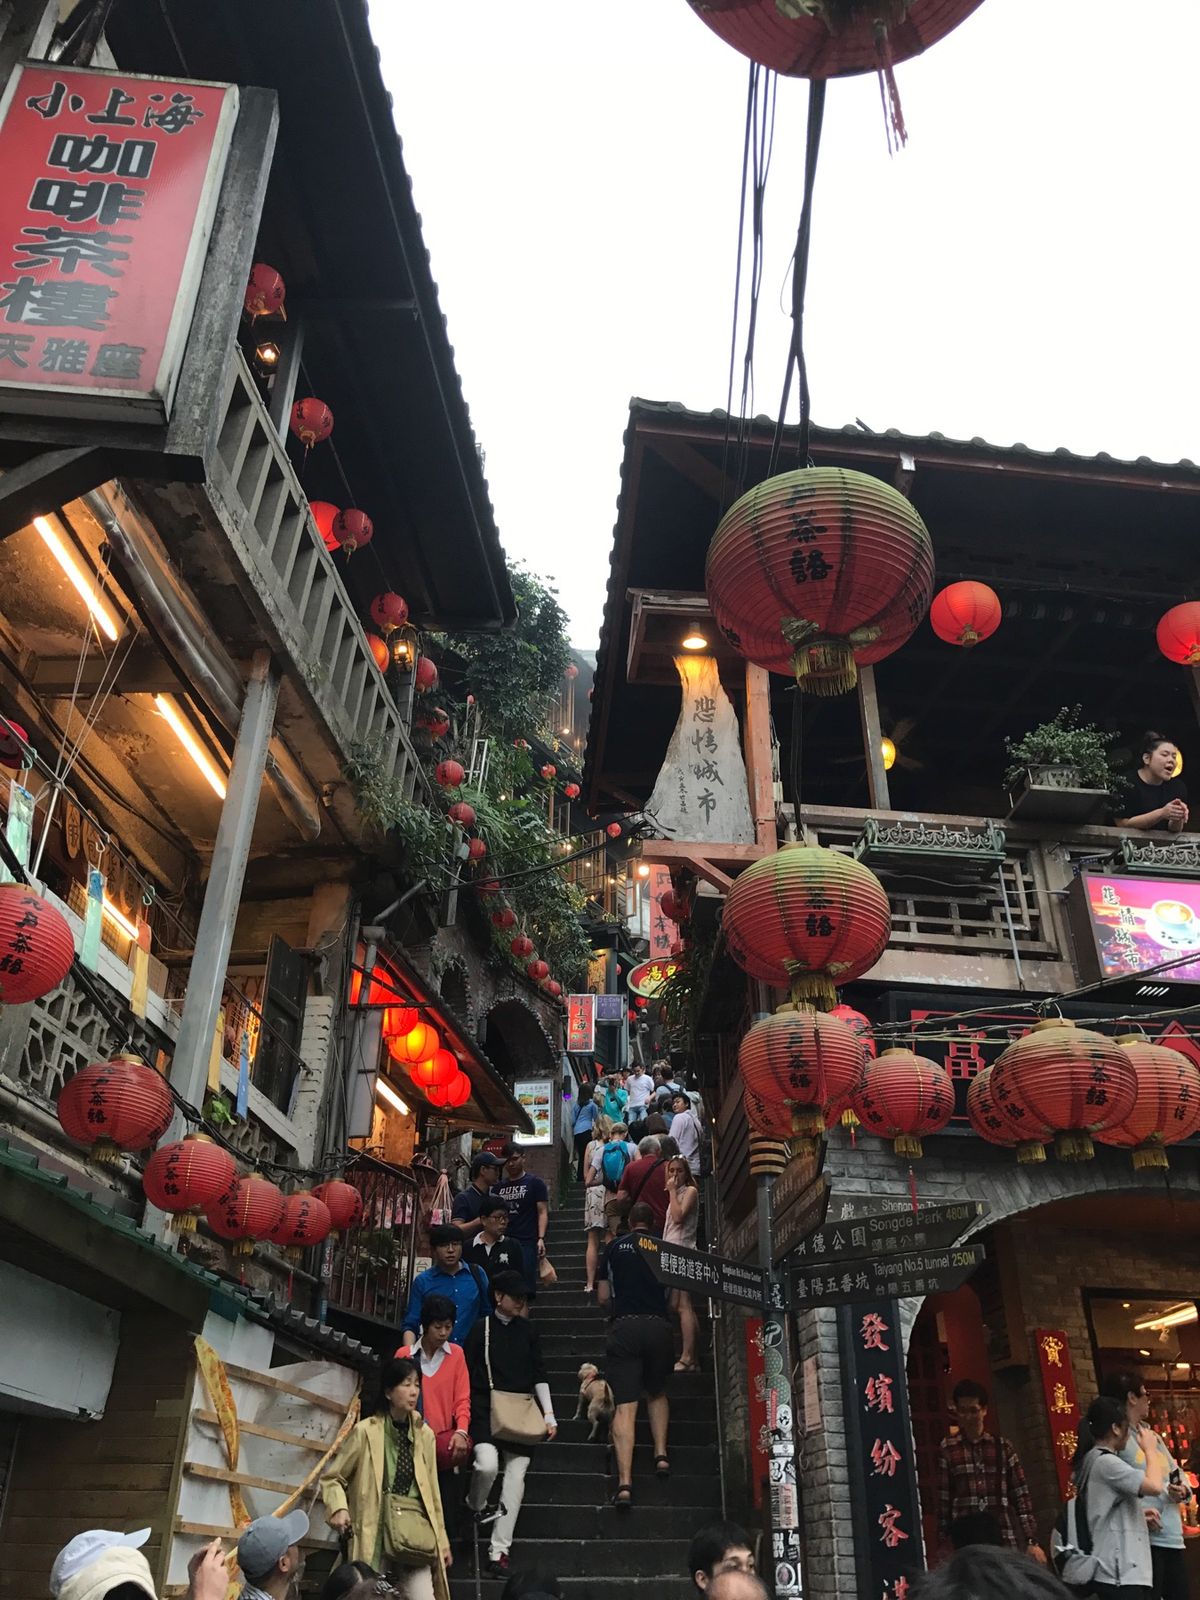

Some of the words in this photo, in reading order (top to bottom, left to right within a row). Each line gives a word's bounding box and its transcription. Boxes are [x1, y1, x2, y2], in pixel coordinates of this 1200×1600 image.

[26, 81, 205, 134] 小上海
[0, 133, 158, 331] 咖啡茶樓
[692, 694, 725, 826] 悲情城市
[1101, 886, 1140, 970] 悲情城市
[499, 1185, 528, 1195] DUKE
[870, 1216, 913, 1233] Songde
[916, 1211, 943, 1226] Park
[946, 1205, 969, 1221] 480M
[660, 1250, 721, 1285] 輕便路遊客中心
[873, 1261, 903, 1277] Taiyang
[904, 1257, 924, 1272] No.5
[925, 1255, 950, 1270] tunnel
[952, 1252, 976, 1268] 250M
[796, 1272, 870, 1299] 臺陽五番坑
